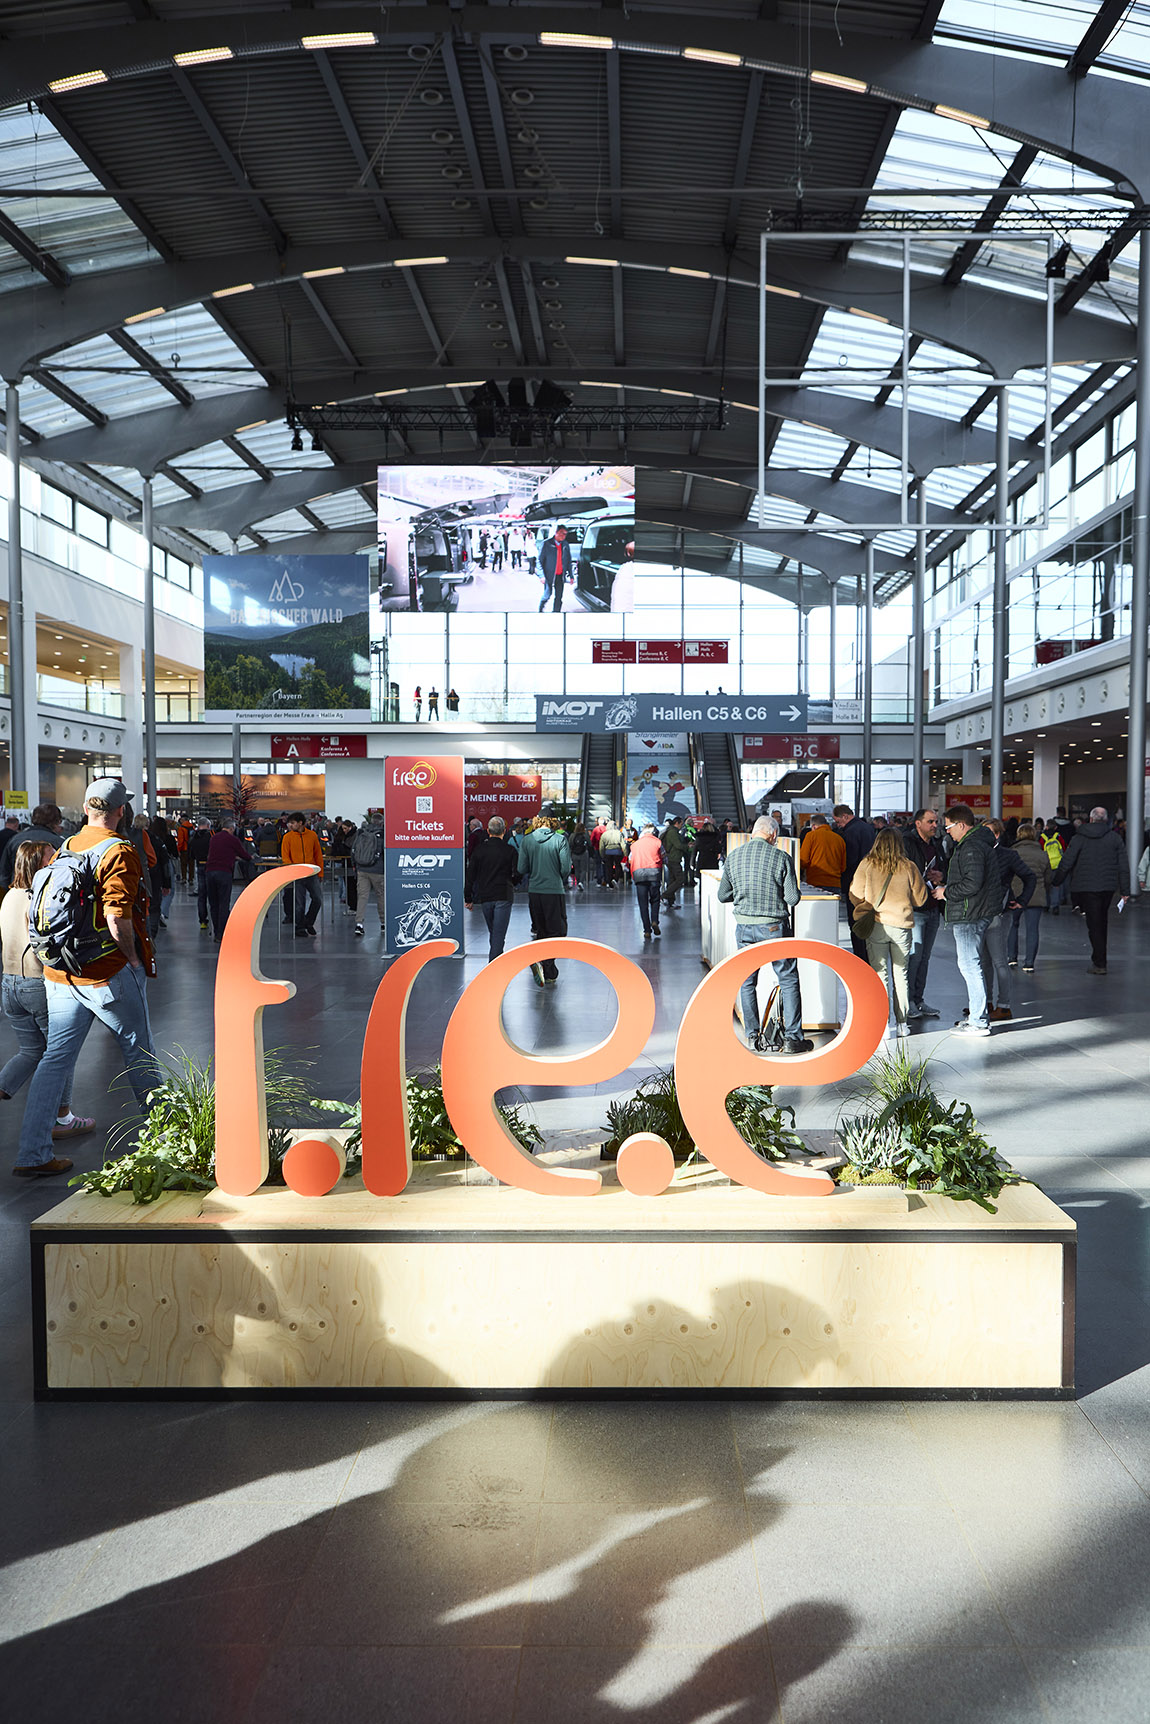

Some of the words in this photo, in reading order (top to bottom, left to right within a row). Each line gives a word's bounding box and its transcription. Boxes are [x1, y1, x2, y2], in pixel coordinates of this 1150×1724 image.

[311, 608, 343, 624] WALD
[278, 691, 303, 701] Bayern
[652, 706, 702, 720] Hallen
[707, 706, 729, 720] C5
[731, 706, 742, 720] &
[745, 706, 767, 720] C6
[286, 743, 300, 757] A
[469, 794, 498, 802] MEINE
[499, 794, 538, 802] FREIZEIT.
[405, 819, 445, 832] Tickets
[394, 833, 410, 841] bitte
[411, 833, 430, 841] online
[431, 833, 455, 841] kaufen!
